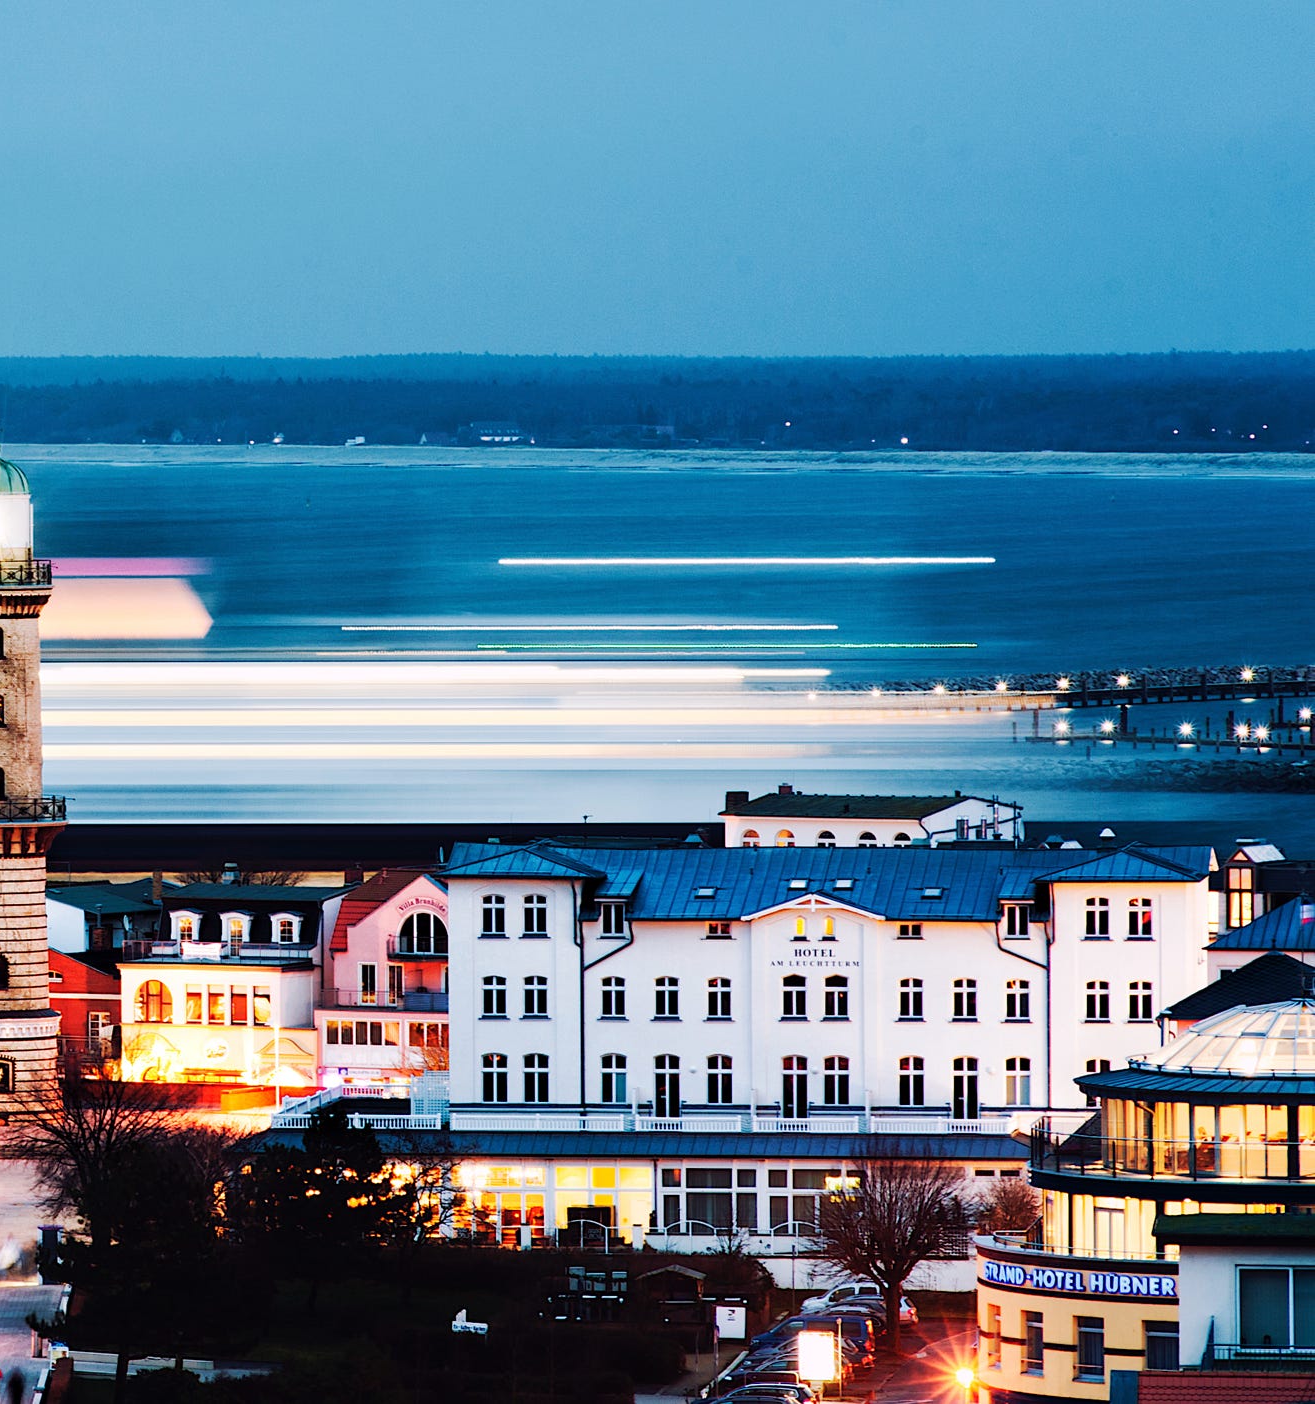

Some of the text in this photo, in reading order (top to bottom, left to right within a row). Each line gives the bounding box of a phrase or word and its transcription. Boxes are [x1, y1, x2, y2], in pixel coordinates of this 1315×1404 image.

[399, 901, 414, 911] Villa
[794, 948, 836, 957] HOTEL
[984, 1261, 1177, 1297] STRAND-HOTEL HÜBNER
